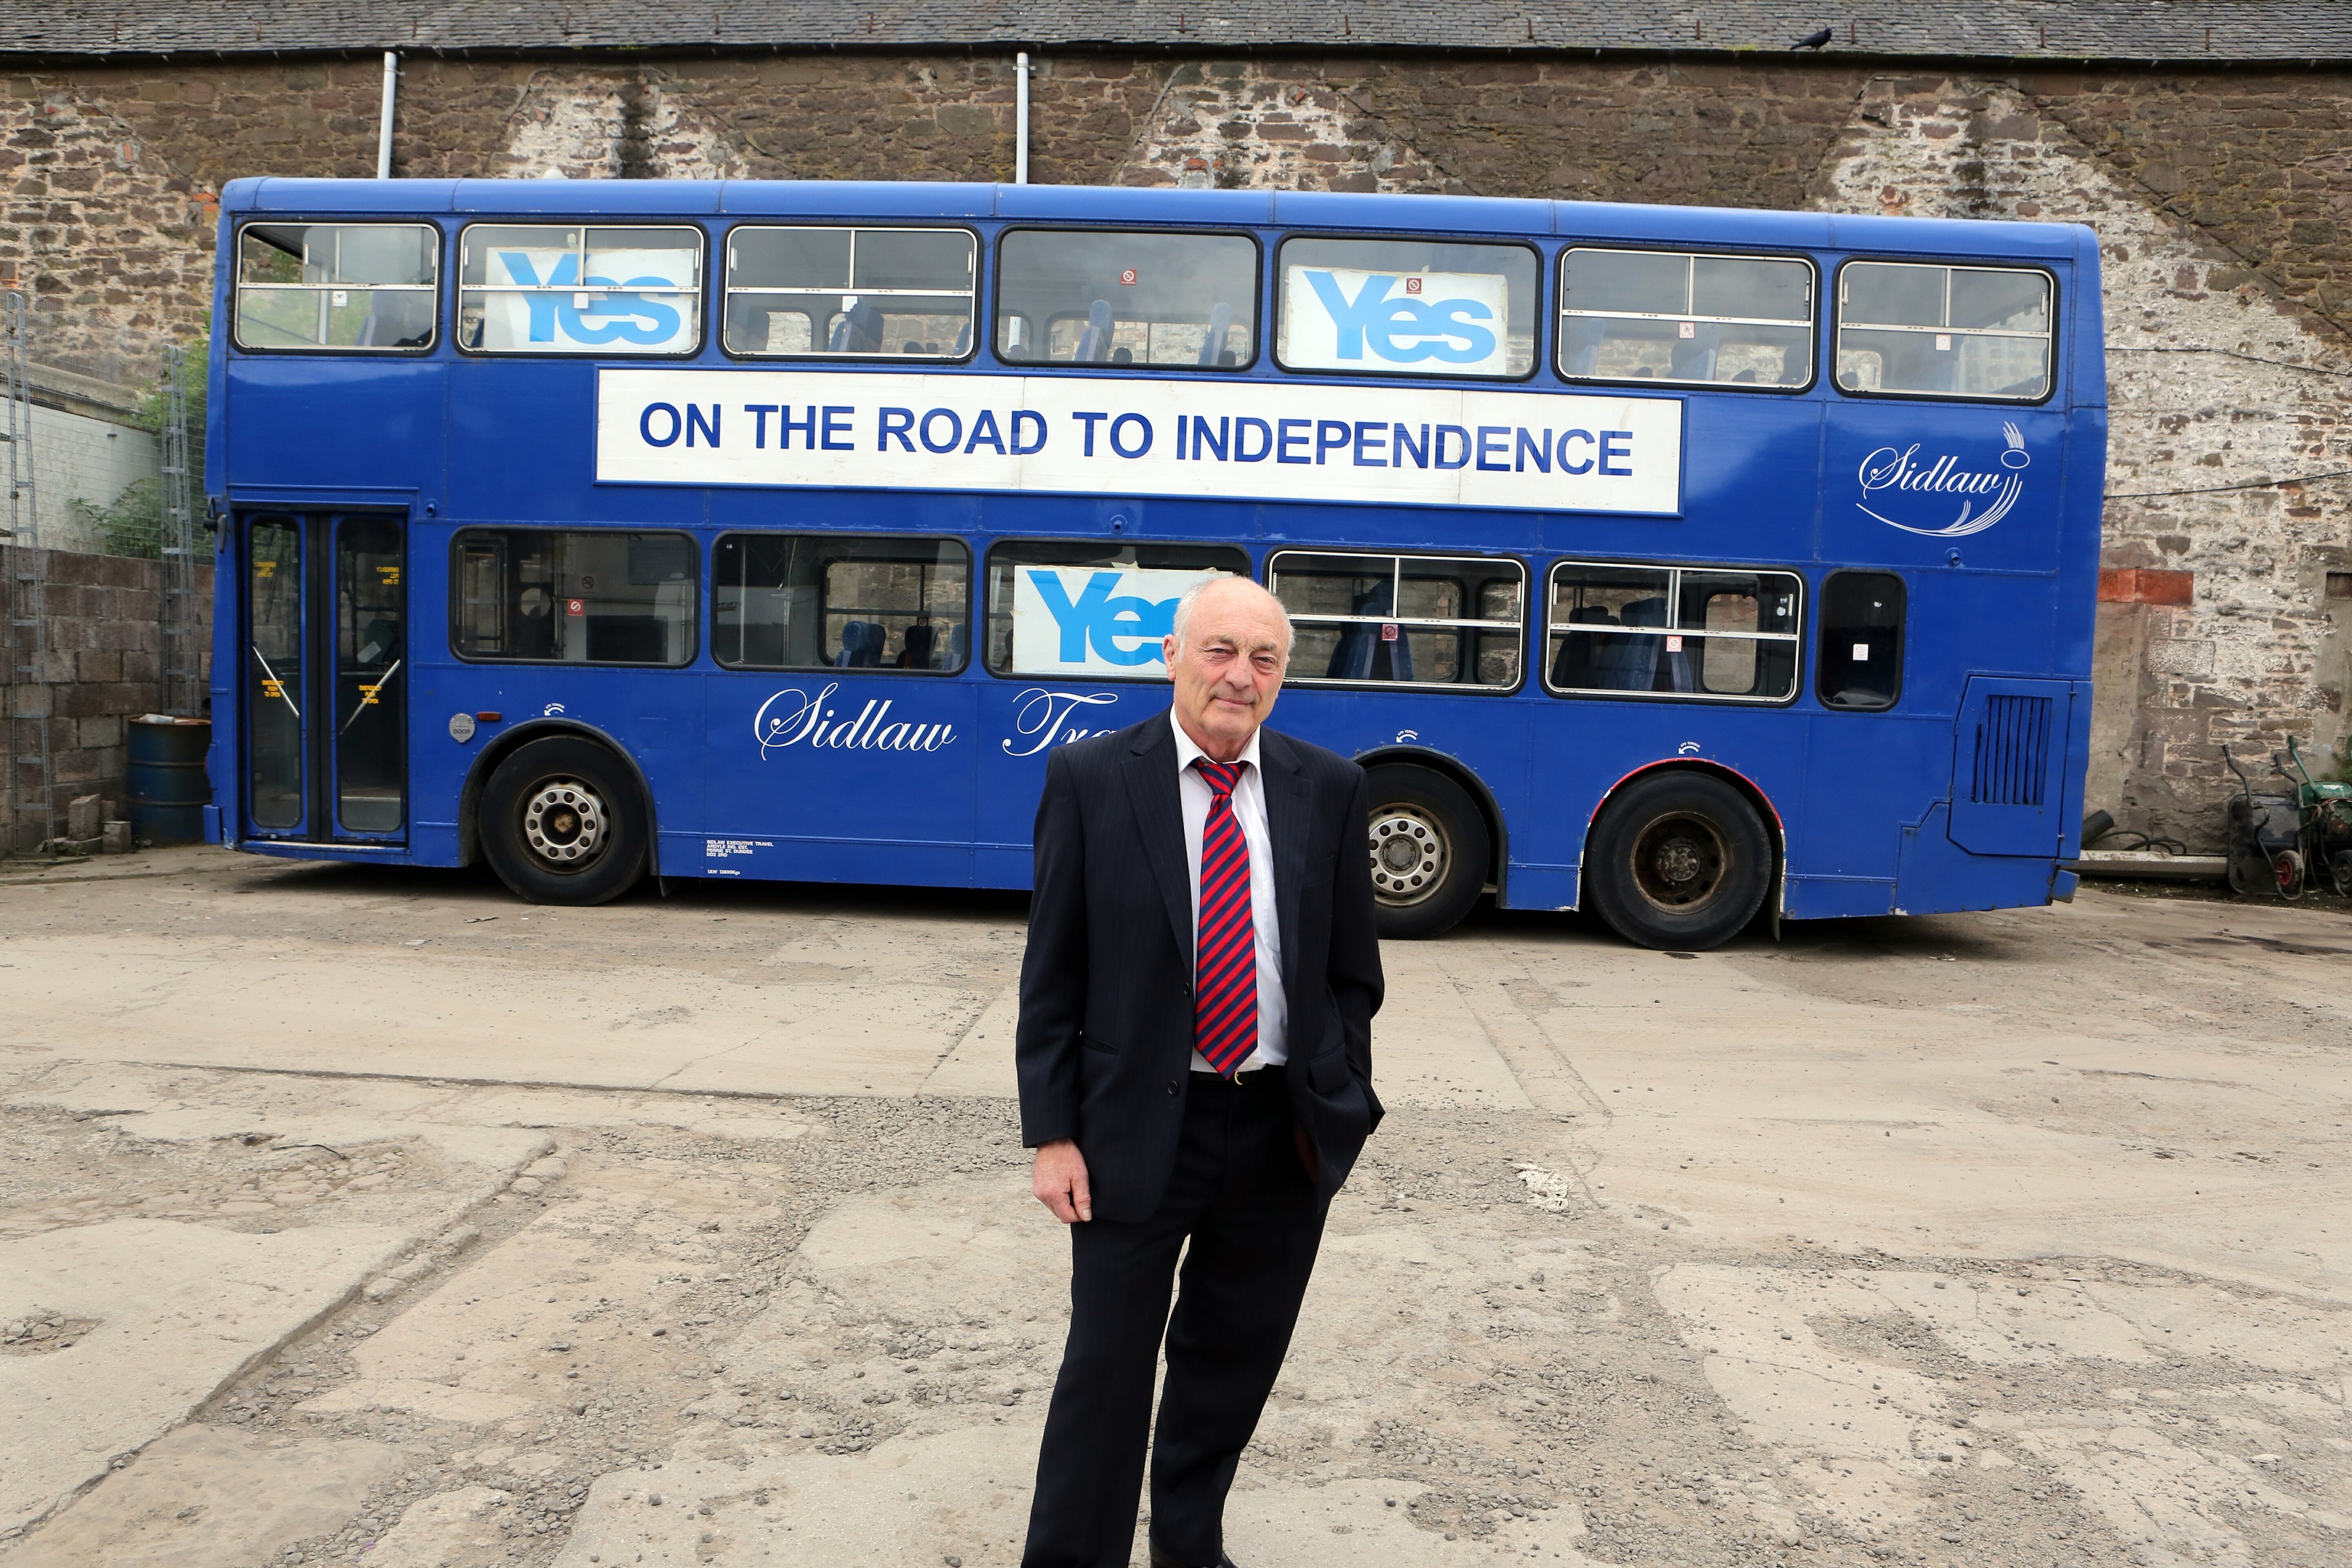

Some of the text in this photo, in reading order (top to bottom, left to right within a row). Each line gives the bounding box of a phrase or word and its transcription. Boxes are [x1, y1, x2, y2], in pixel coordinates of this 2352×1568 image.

[498, 252, 681, 345] Yes
[1302, 270, 1496, 364] Yes
[640, 402, 1633, 475] ON THE ROAD TO INDEPENDENCE
[1858, 443, 2002, 499] Sidlaw
[754, 682, 957, 761] Sidlaw
